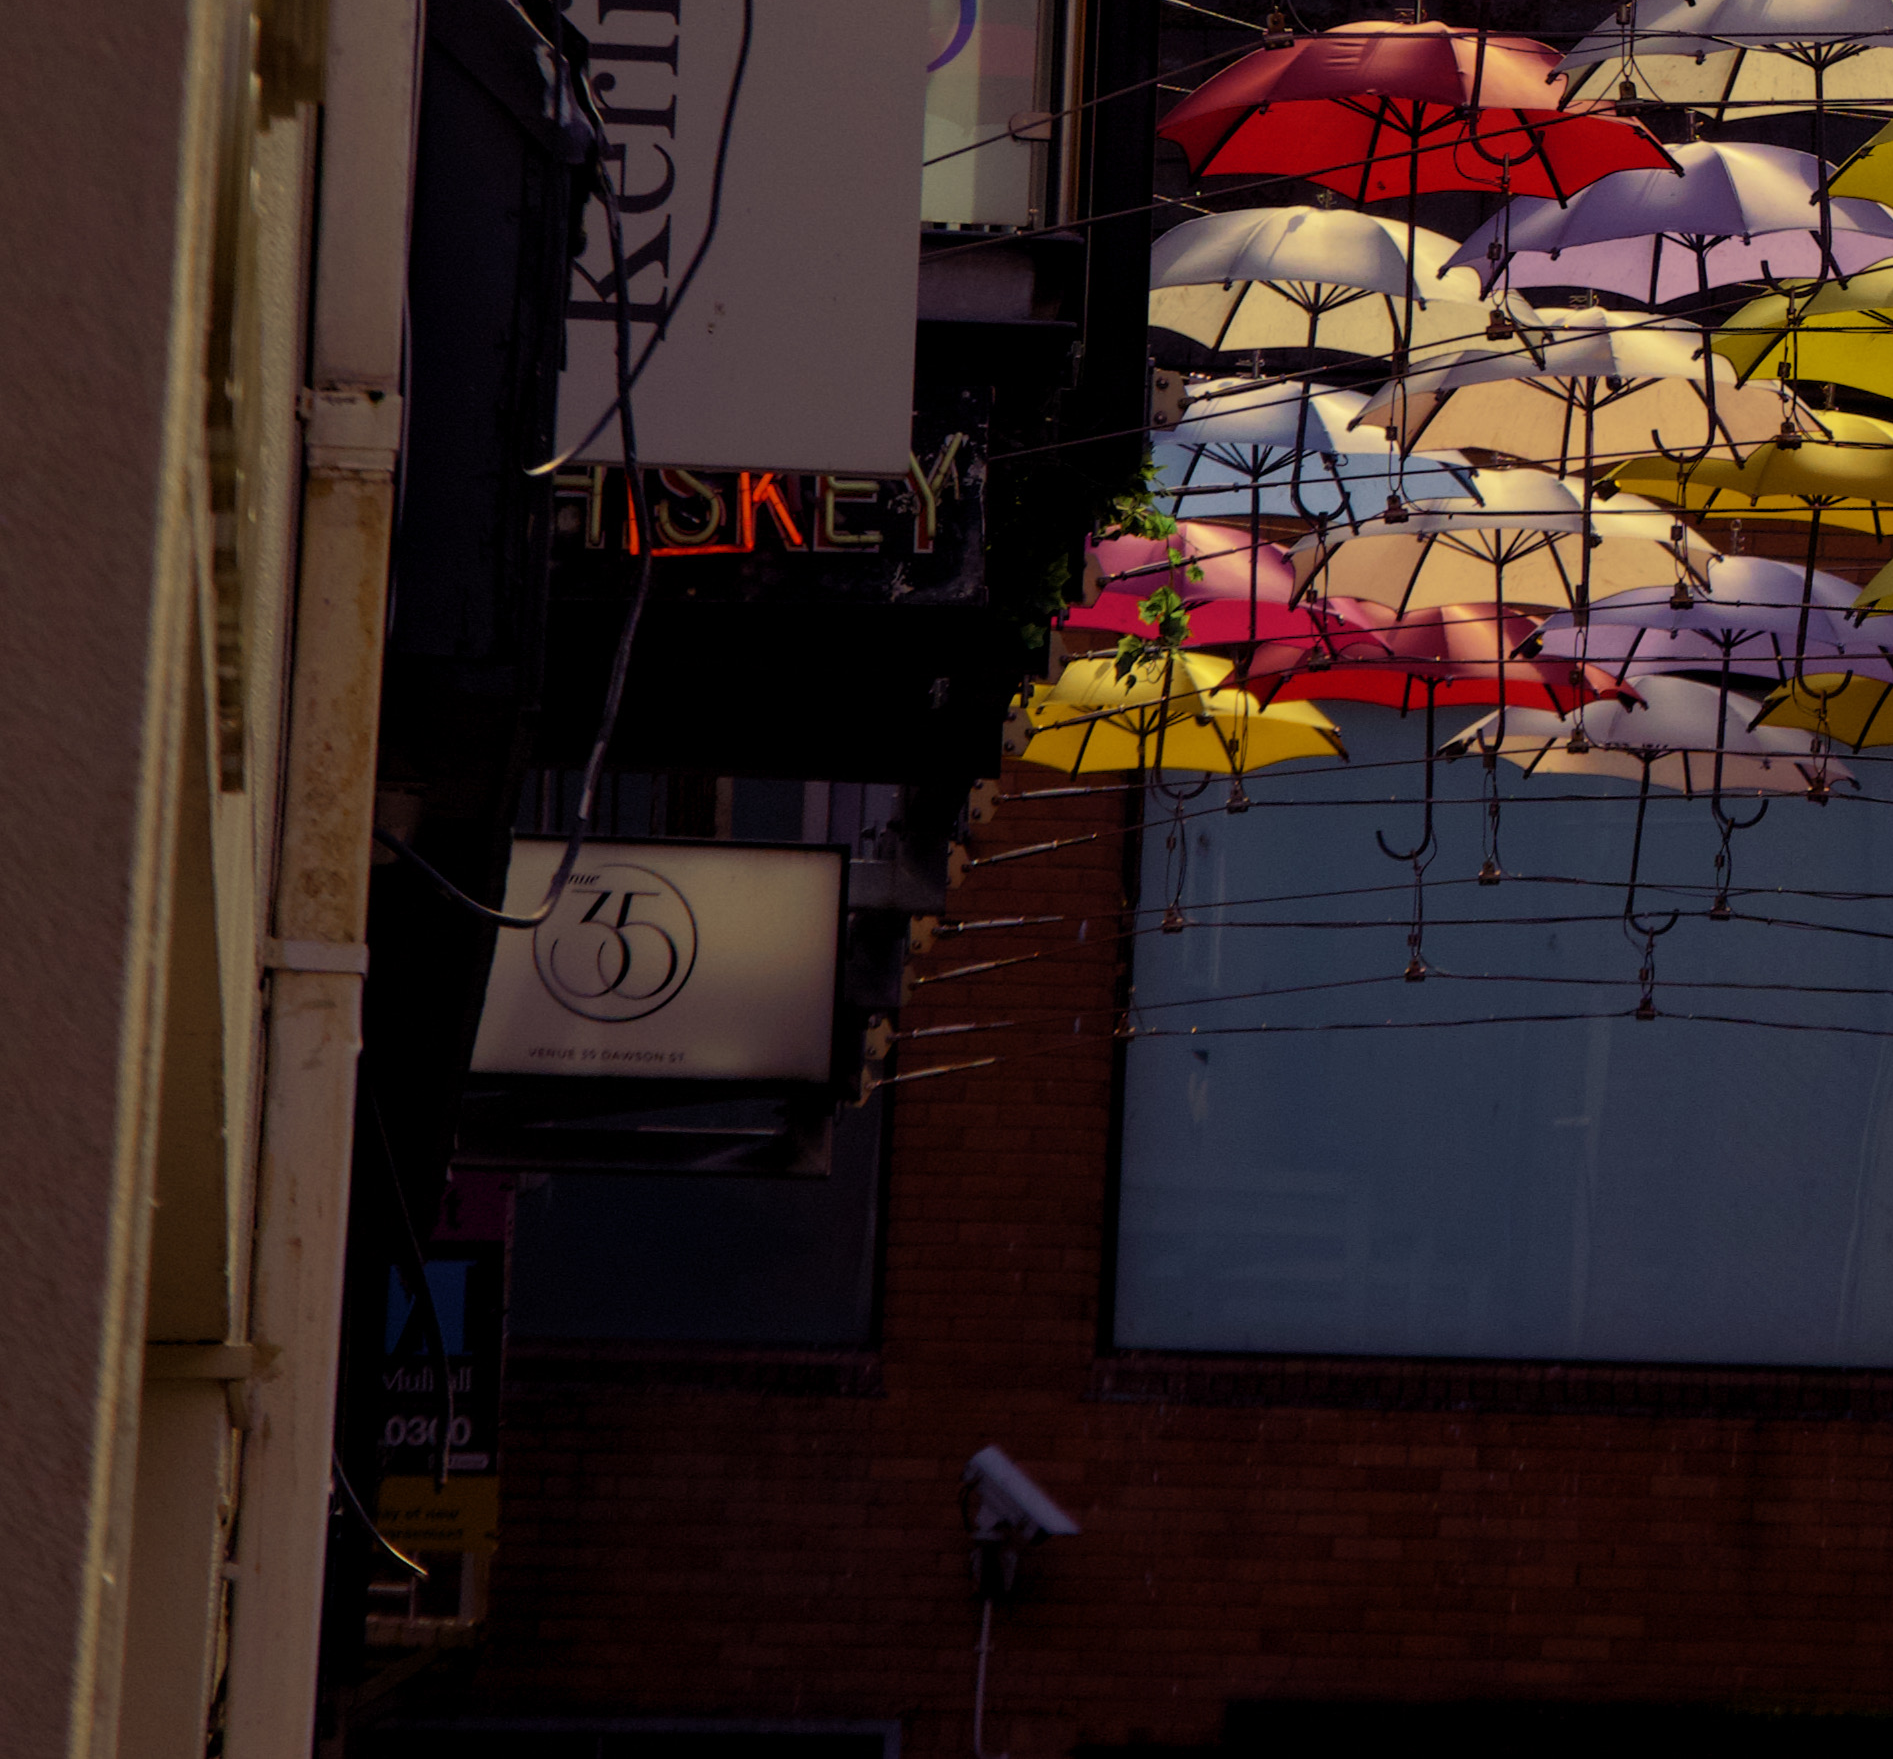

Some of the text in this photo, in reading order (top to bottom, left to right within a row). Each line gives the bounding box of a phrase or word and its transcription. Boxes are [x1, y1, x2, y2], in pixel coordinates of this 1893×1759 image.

[550, 890, 678, 1000] 35
[528, 1046, 576, 1060] VENUE
[600, 1048, 664, 1062] DAWSON
